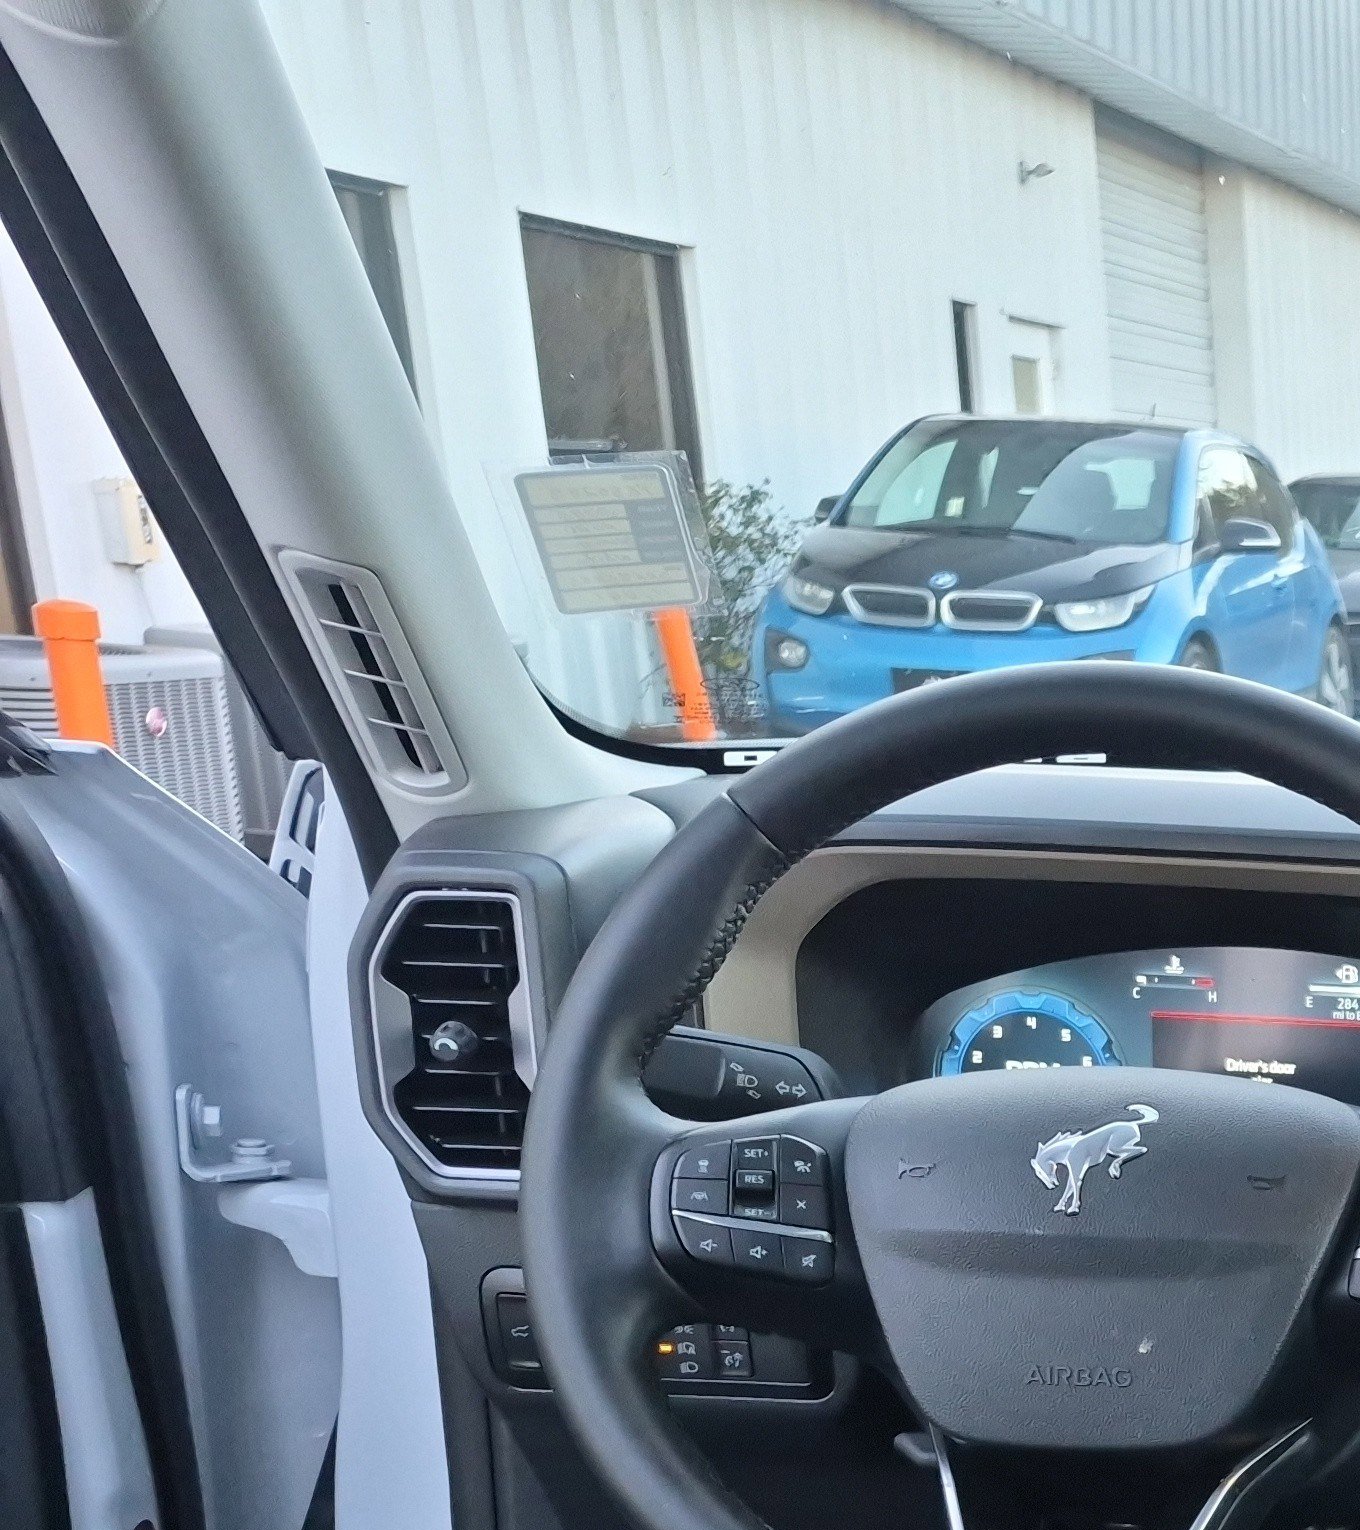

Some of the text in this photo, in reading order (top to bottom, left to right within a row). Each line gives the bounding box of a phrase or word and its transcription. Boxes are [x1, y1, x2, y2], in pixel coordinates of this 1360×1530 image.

[1133, 987, 1141, 999] C
[1208, 992, 1217, 1003] H
[1305, 996, 1313, 1008] E
[1337, 999, 1359, 1011] 284
[1346, 1011, 1356, 1020] to
[1026, 1017, 1037, 1029] 4
[993, 1026, 1003, 1039] 3
[1061, 1029, 1071, 1042] 5
[973, 1051, 983, 1064] 2
[1225, 1058, 1297, 1075] Driver's door
[745, 1175, 765, 1184] RES
[1026, 1364, 1132, 1388] AIRBAG
